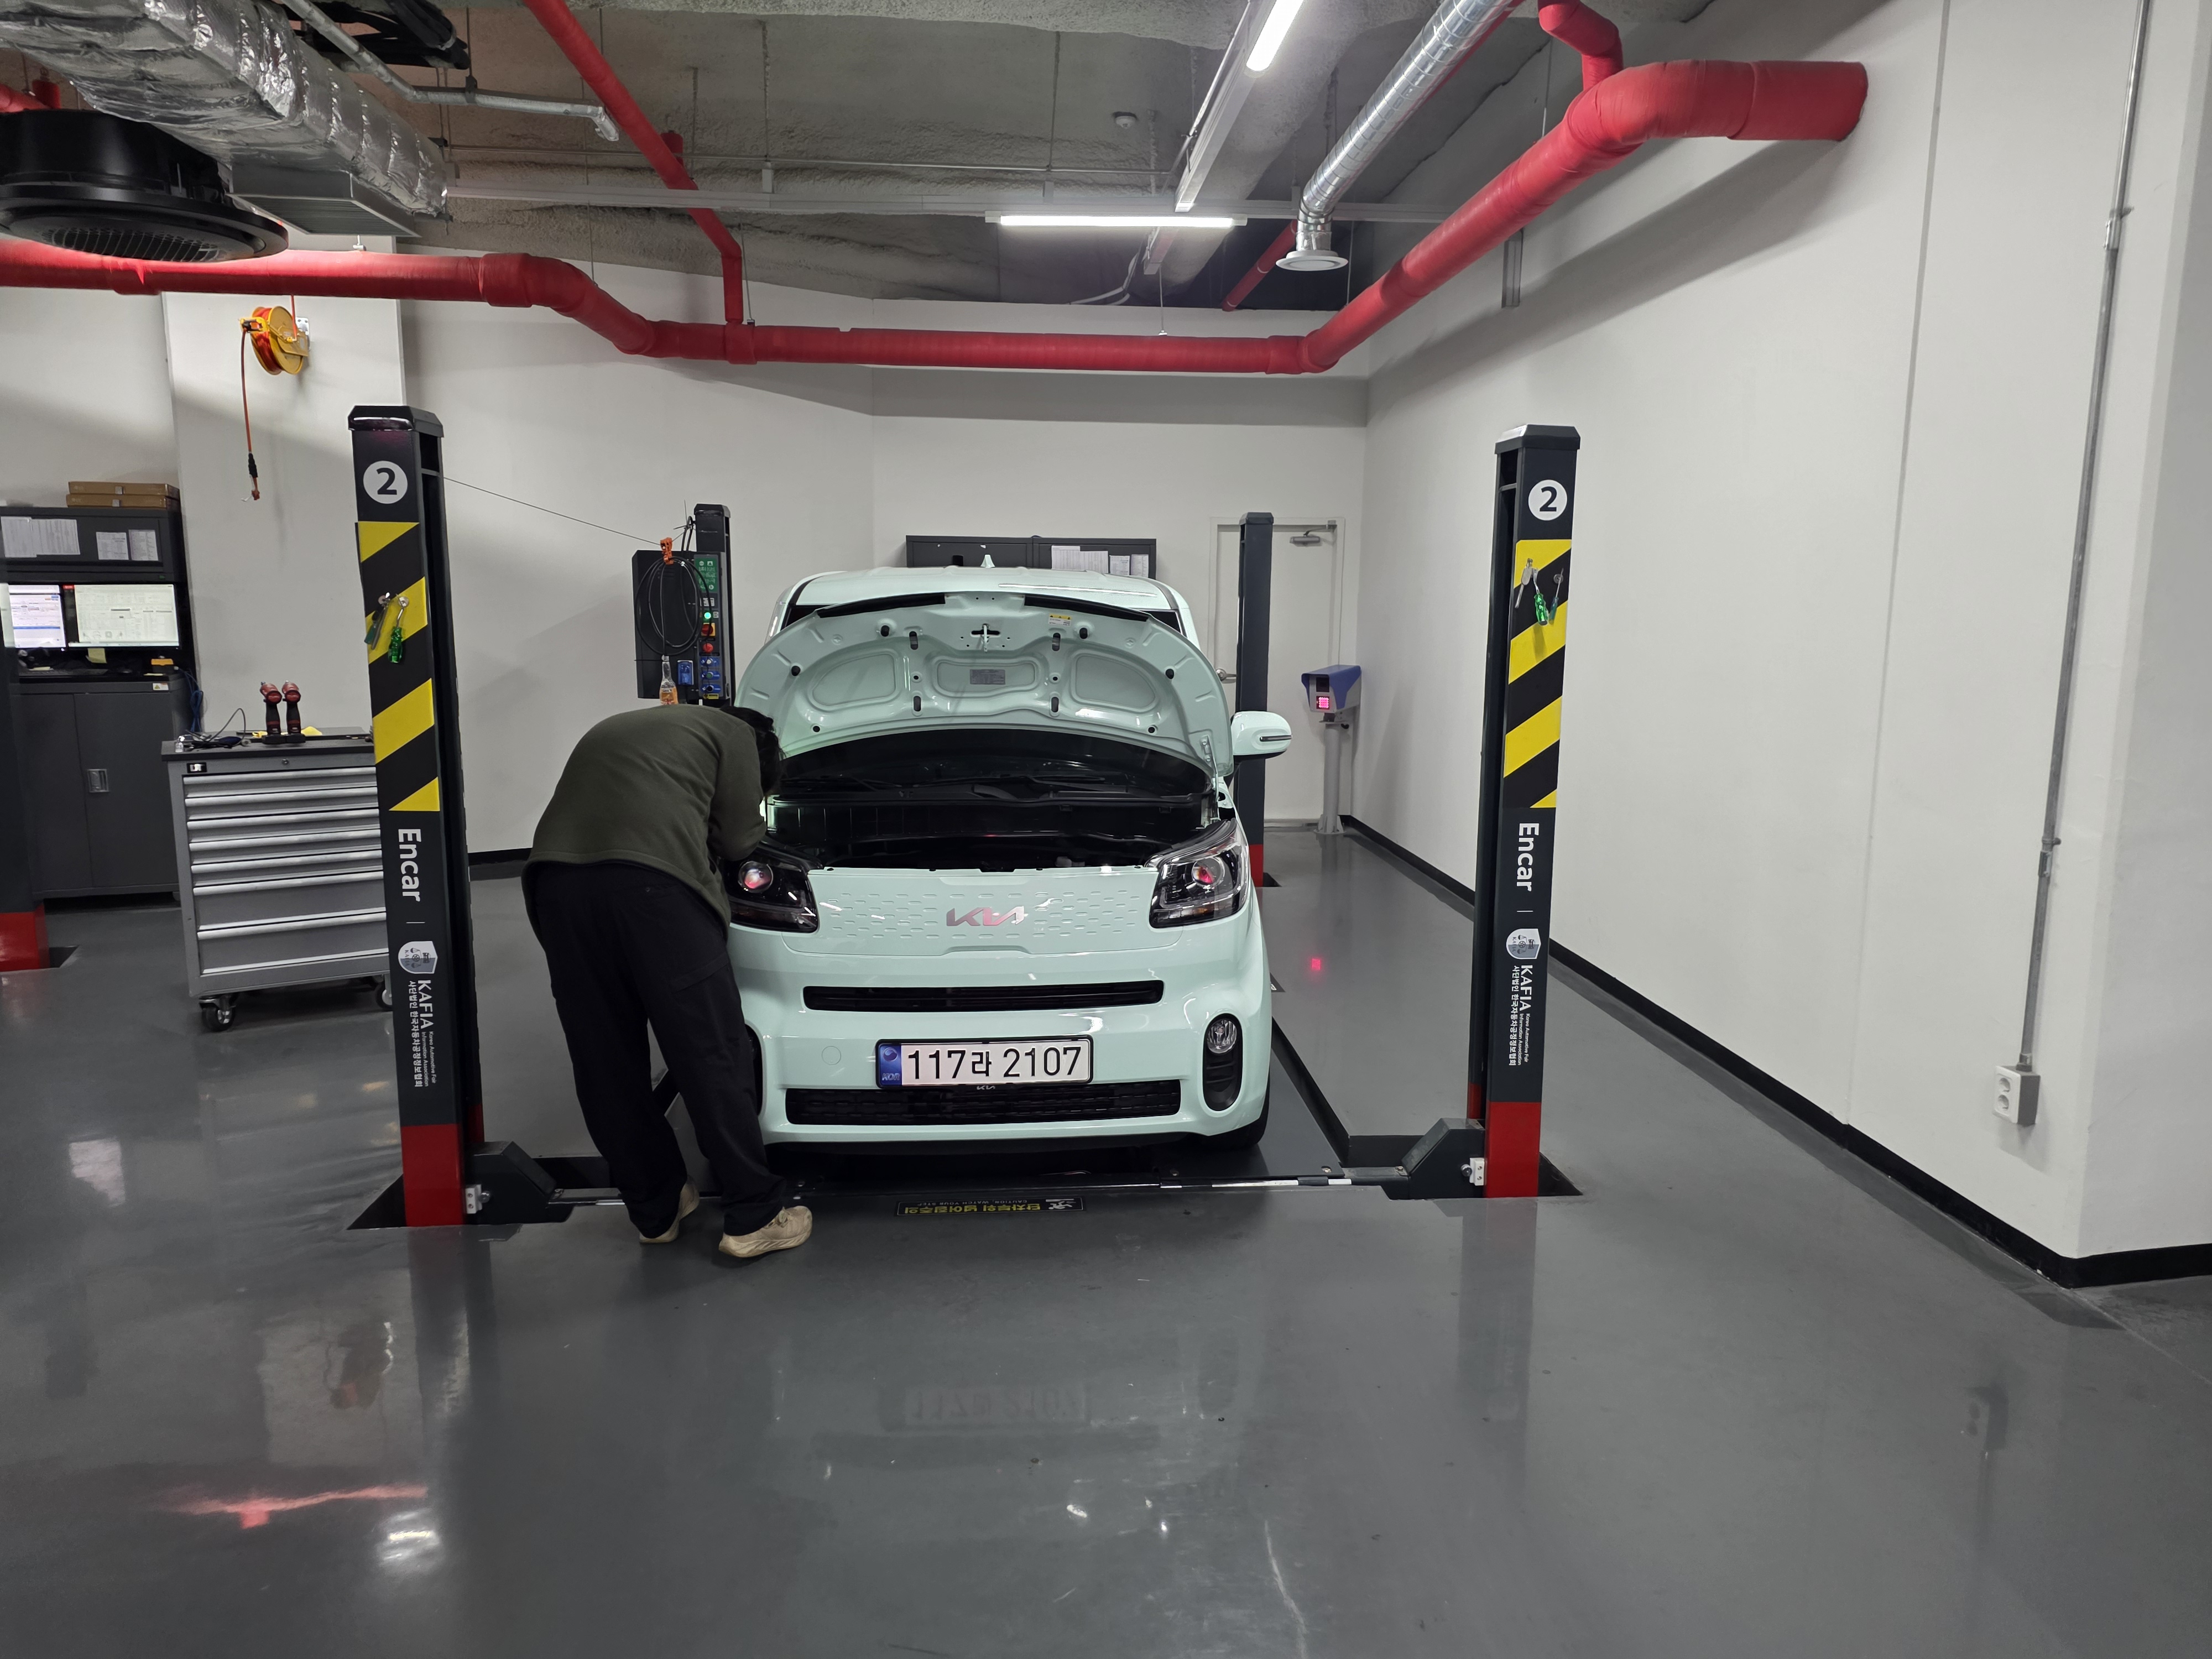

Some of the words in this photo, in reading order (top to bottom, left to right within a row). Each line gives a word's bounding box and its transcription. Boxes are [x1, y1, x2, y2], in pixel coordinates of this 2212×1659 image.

[376, 468, 397, 495] 2
[1540, 486, 1557, 512] 2
[398, 829, 421, 902] Encar
[1516, 823, 1540, 891] Encar
[408, 980, 418, 1008] 사단법인
[1511, 966, 1520, 992] 사단법인
[1520, 965, 1533, 1011] KAFIA
[418, 980, 434, 1029] KAFIA
[410, 1011, 423, 1087] 한국자동차공정정보협회
[1509, 994, 1519, 1066] 한국자동차공정정보협회
[908, 1050, 992, 1079] 117라
[1003, 1046, 1081, 1077] 2107
[983, 1203, 1041, 1212] 단차부위
